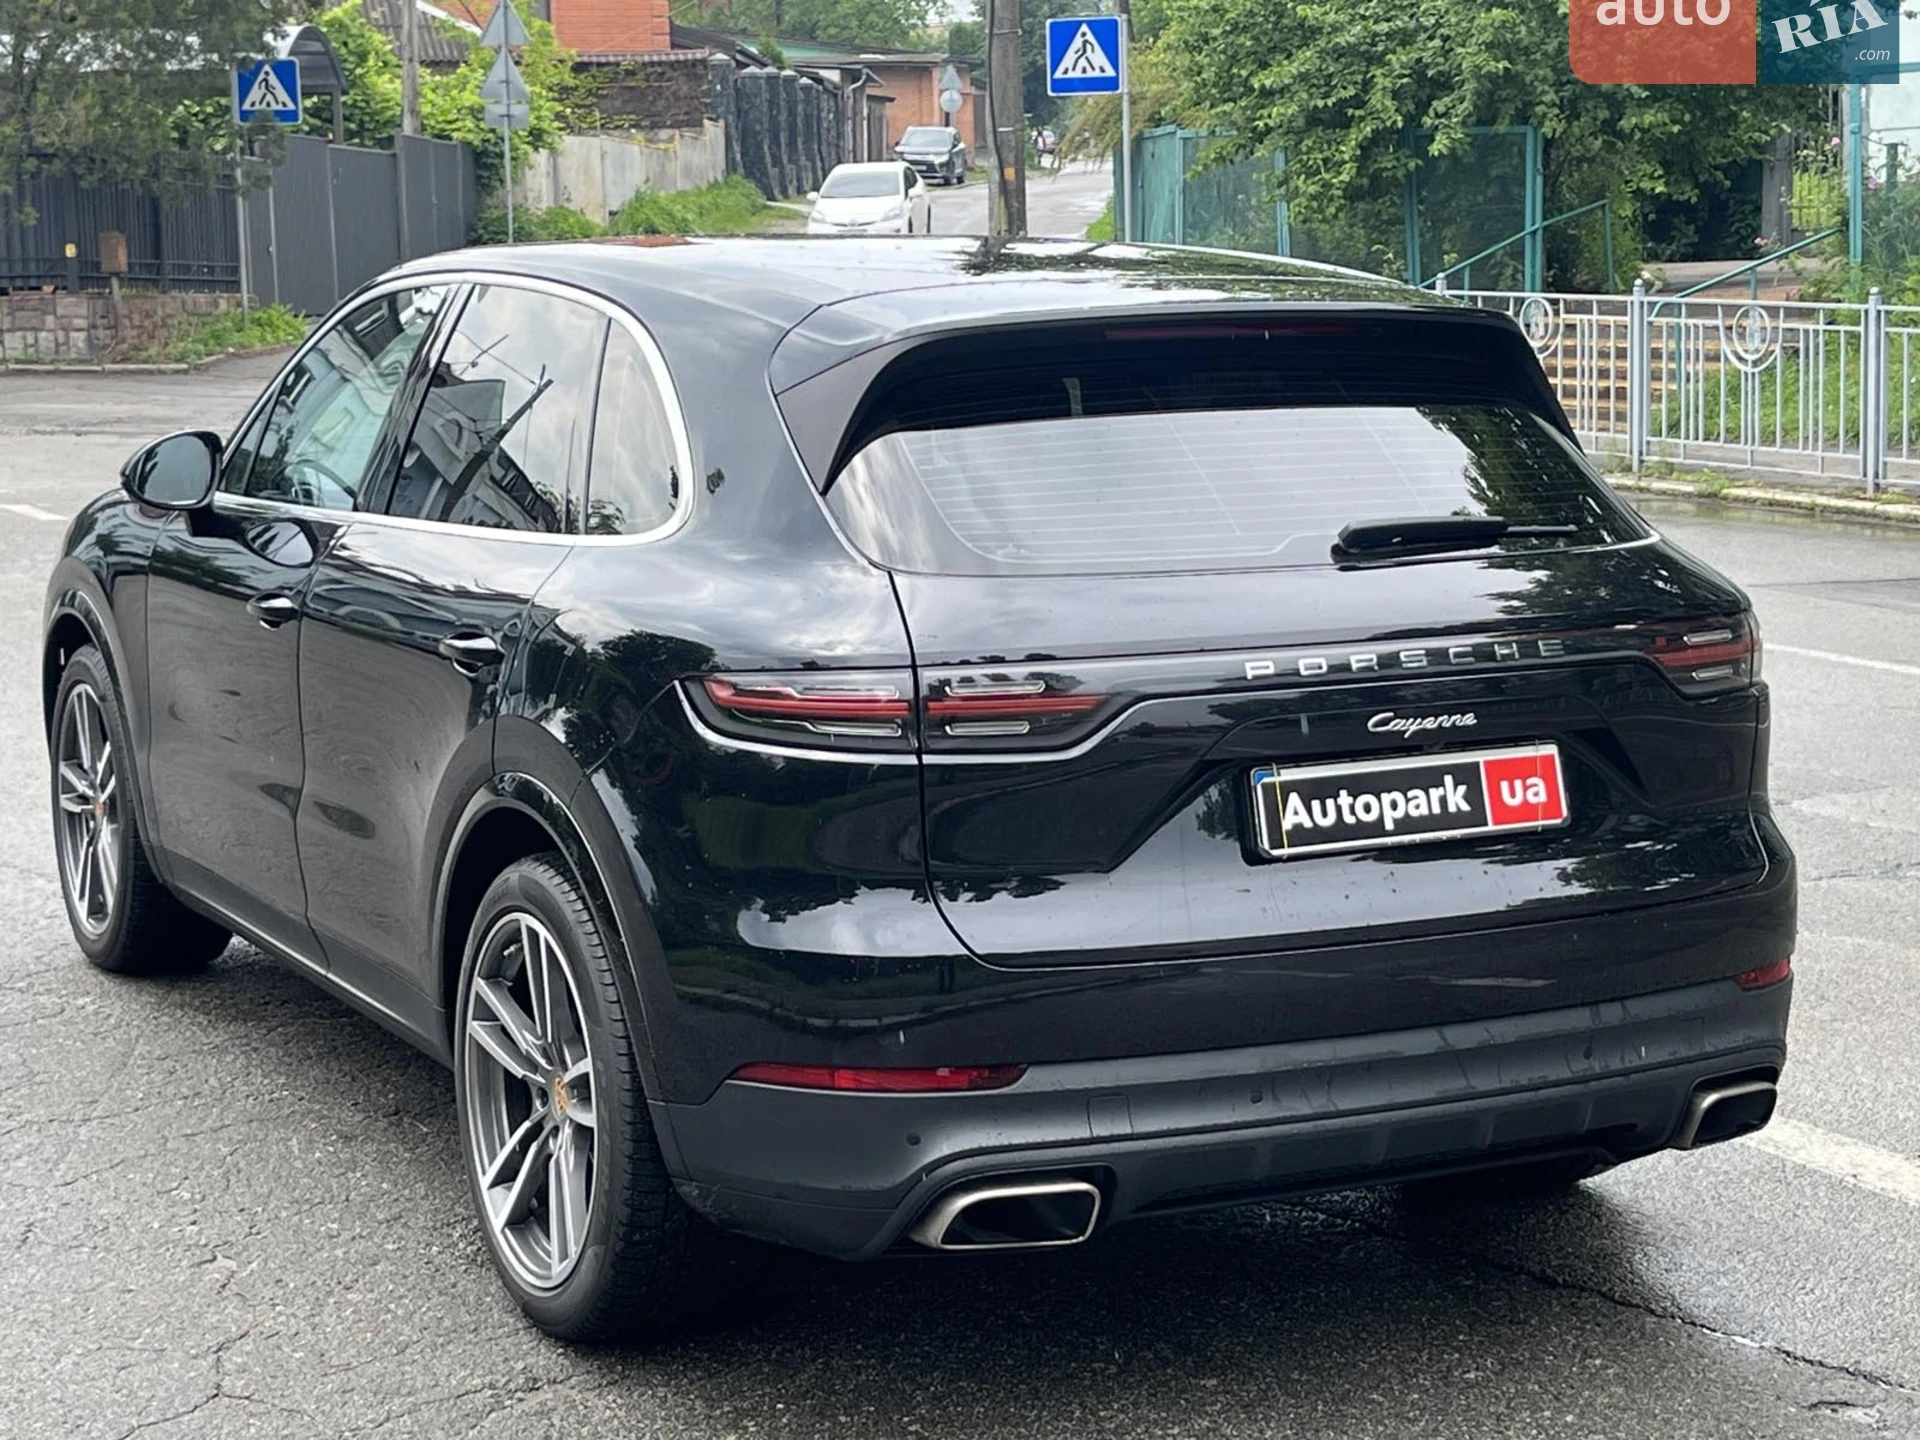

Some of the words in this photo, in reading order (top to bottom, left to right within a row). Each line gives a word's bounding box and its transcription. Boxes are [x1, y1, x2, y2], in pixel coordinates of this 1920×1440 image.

[1244, 638, 1566, 679] PORSCHE
[1367, 712, 1478, 738] Cayenne
[1282, 774, 1471, 831] Autopark
[1499, 776, 1548, 807] ua
